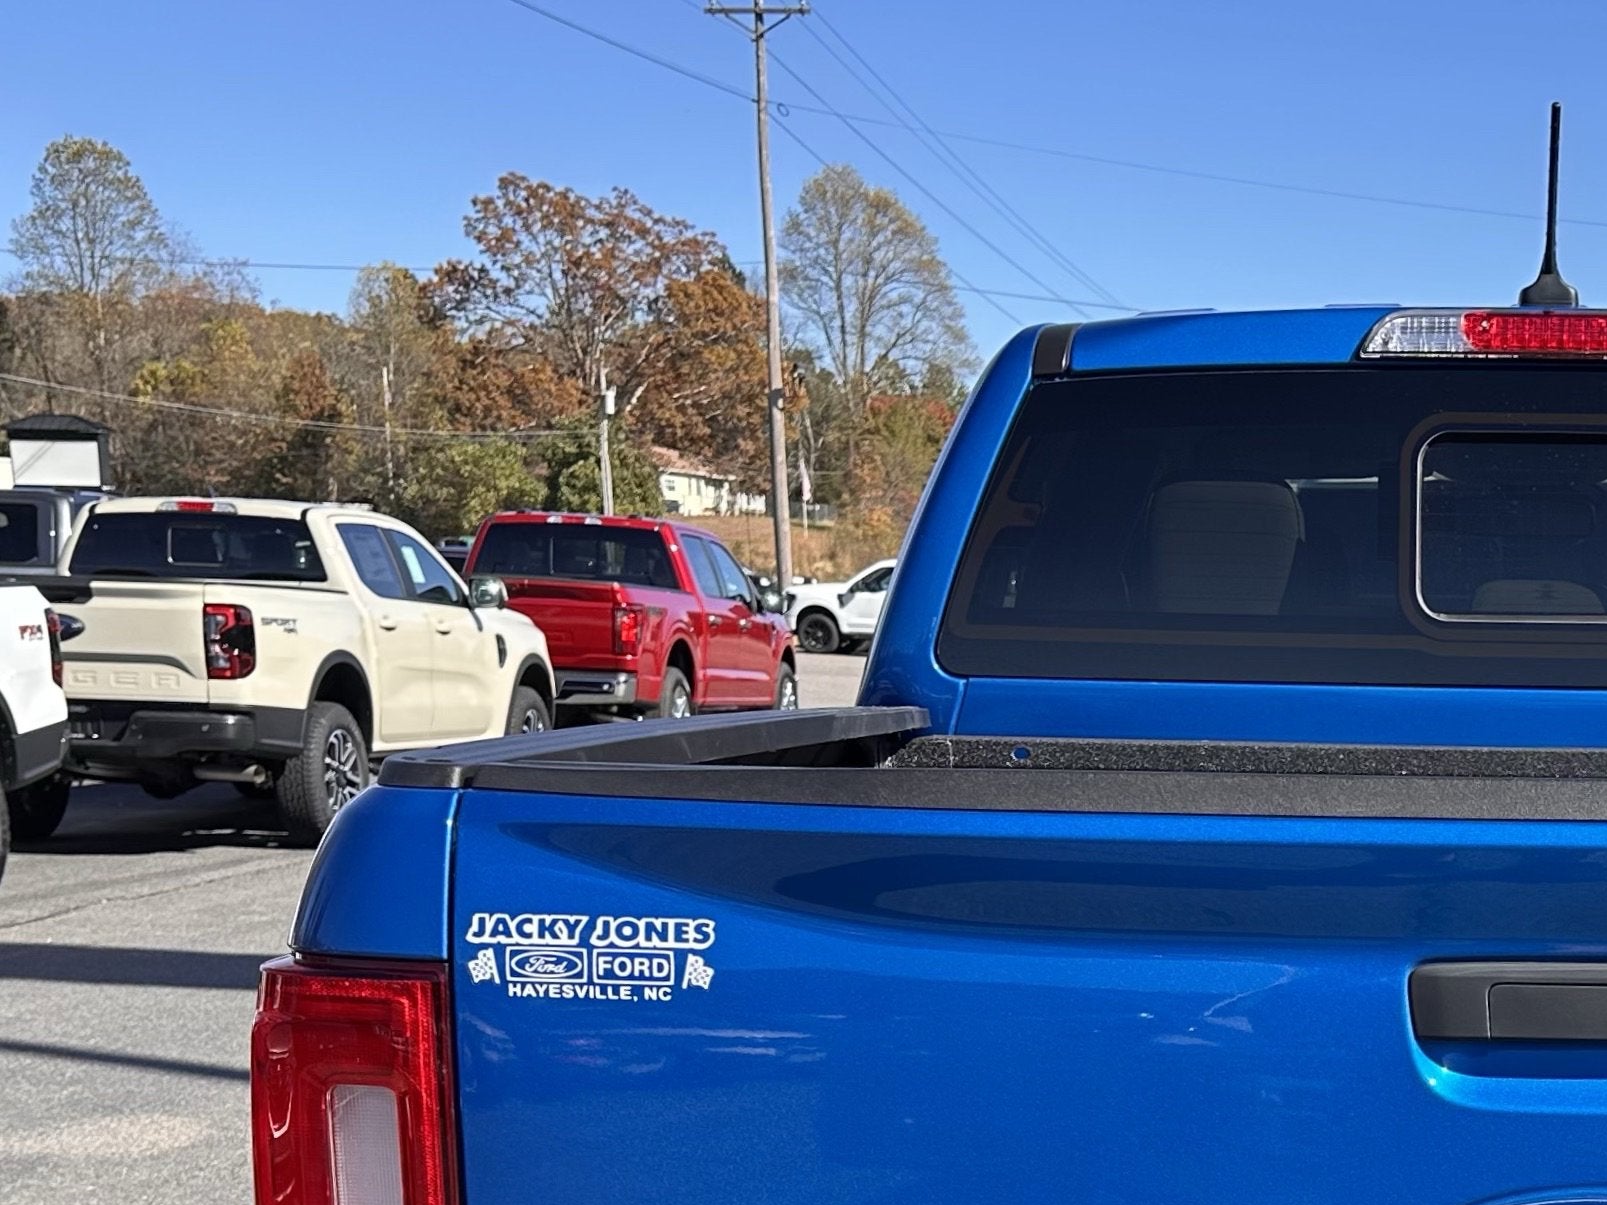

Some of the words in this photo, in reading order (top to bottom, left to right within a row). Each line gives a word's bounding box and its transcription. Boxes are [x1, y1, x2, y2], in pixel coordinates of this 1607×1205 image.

[466, 913, 590, 945] JACKY
[589, 917, 716, 949] JONES
[524, 956, 568, 973] Ford
[598, 957, 669, 978] FORD
[508, 983, 638, 1002] HAYESVILLE,
[643, 986, 672, 1001] NC
